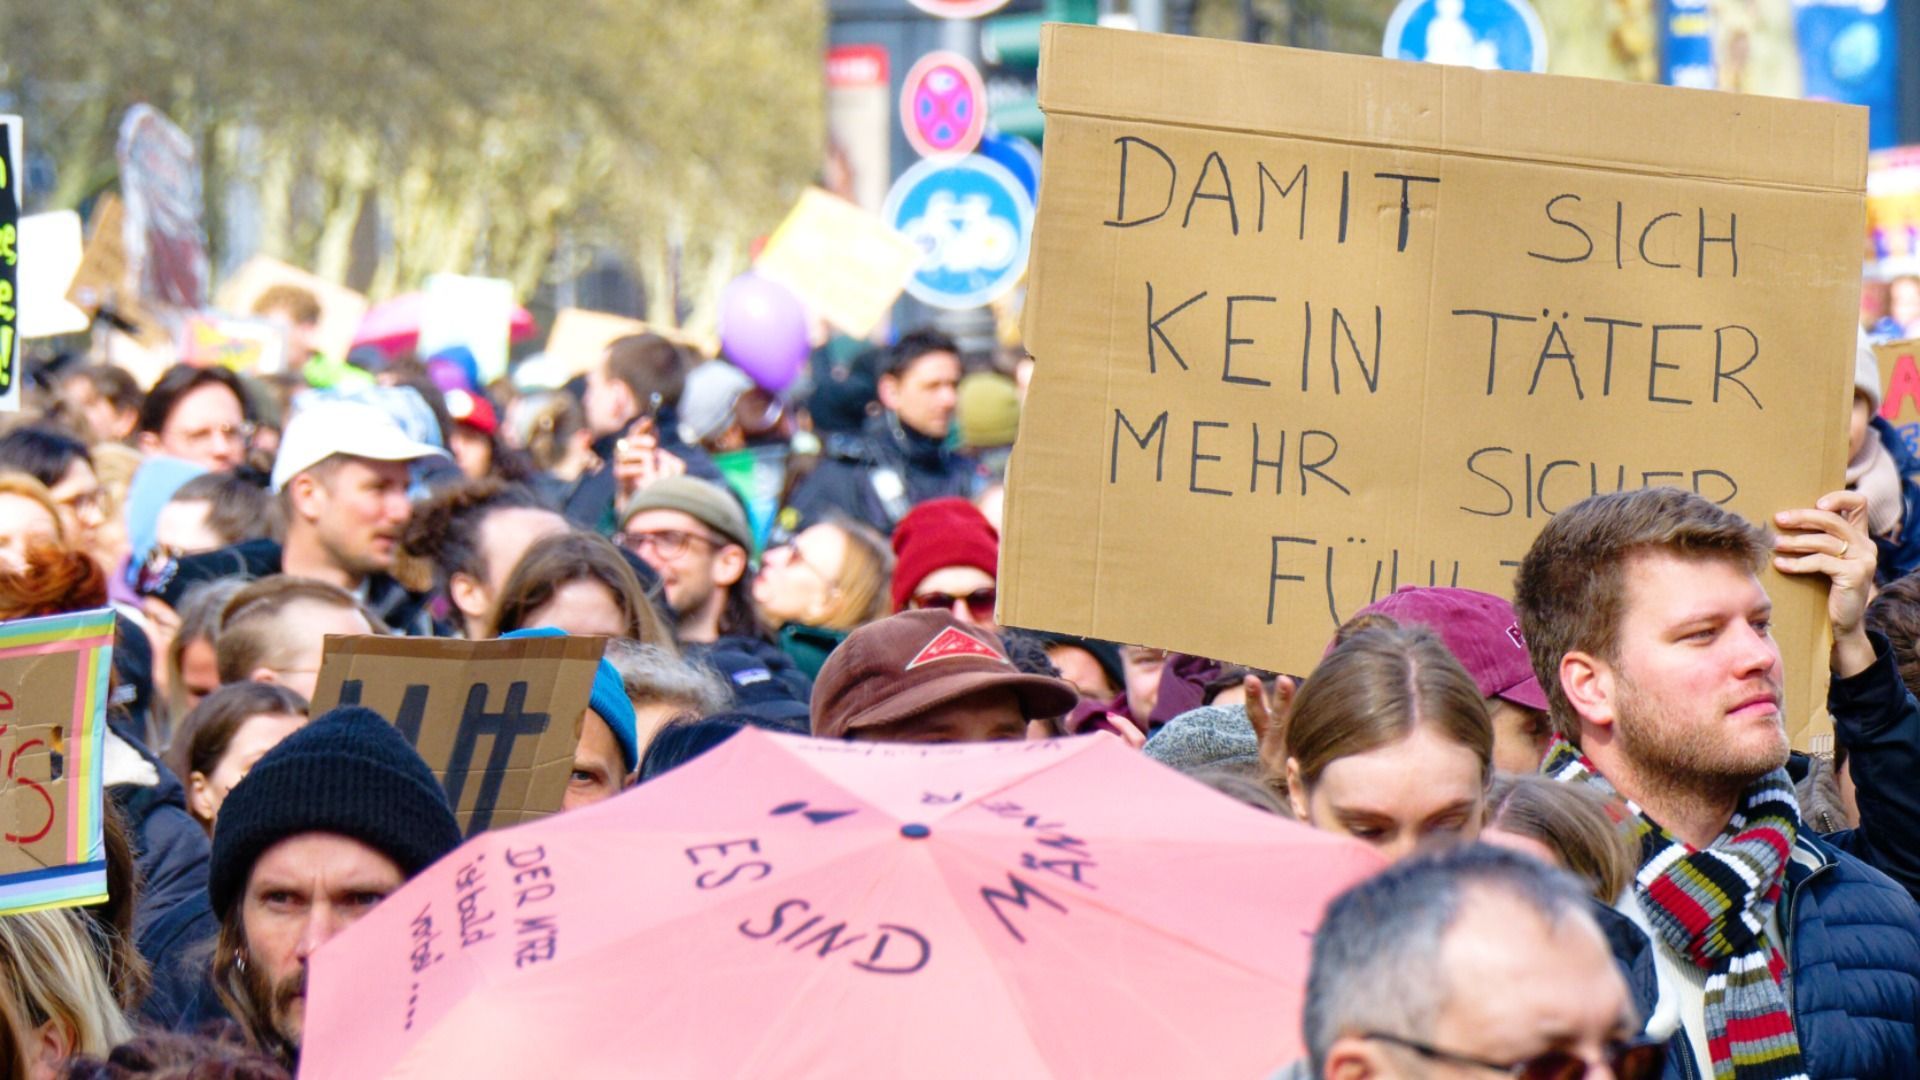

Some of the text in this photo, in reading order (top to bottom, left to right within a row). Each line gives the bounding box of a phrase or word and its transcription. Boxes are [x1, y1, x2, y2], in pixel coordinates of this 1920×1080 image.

[1103, 135, 1740, 278] DAMIT SICH
[1145, 281, 1764, 410] KEIN TÄTER
[1109, 408, 1351, 497] MEHR
[457, 885, 497, 949] bald
[505, 845, 556, 908] DER
[685, 837, 773, 890] ES
[736, 899, 931, 975] SIND
